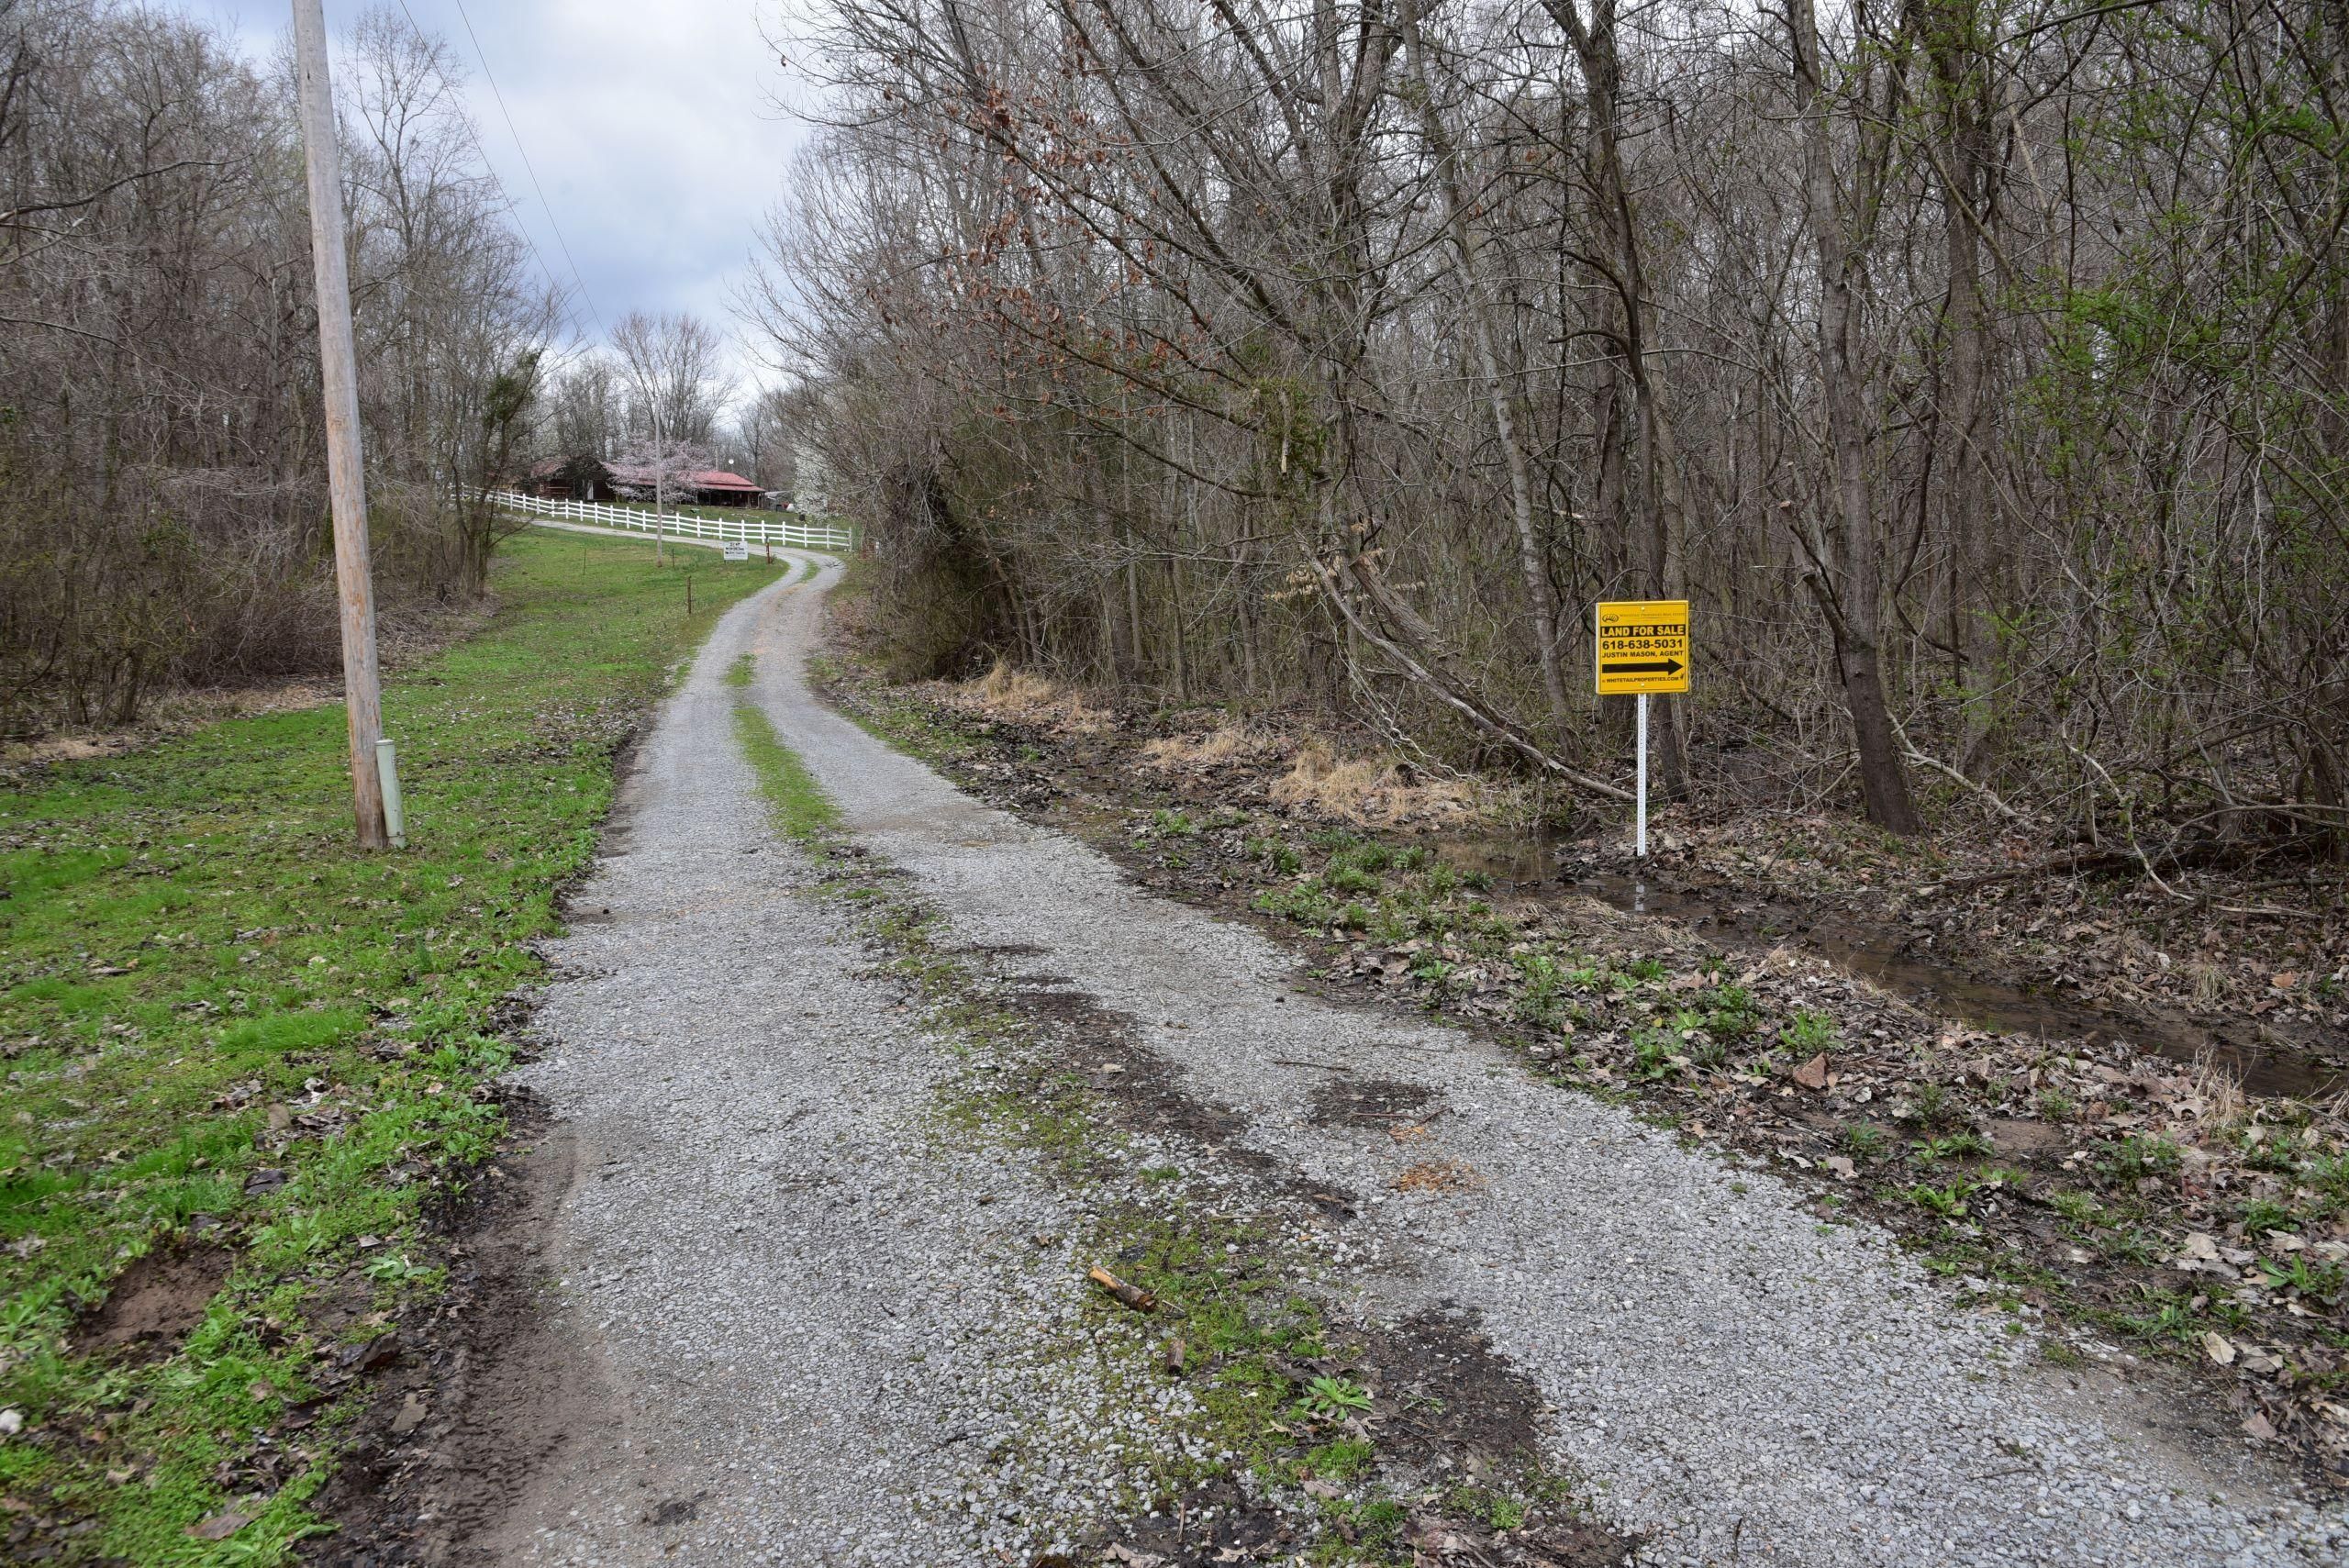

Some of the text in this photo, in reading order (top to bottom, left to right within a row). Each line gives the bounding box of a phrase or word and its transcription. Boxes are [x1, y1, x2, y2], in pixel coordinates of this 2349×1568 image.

[1602, 626, 1684, 637] LAND FOR SALE
[1602, 639, 1683, 650] 618-638-5031
